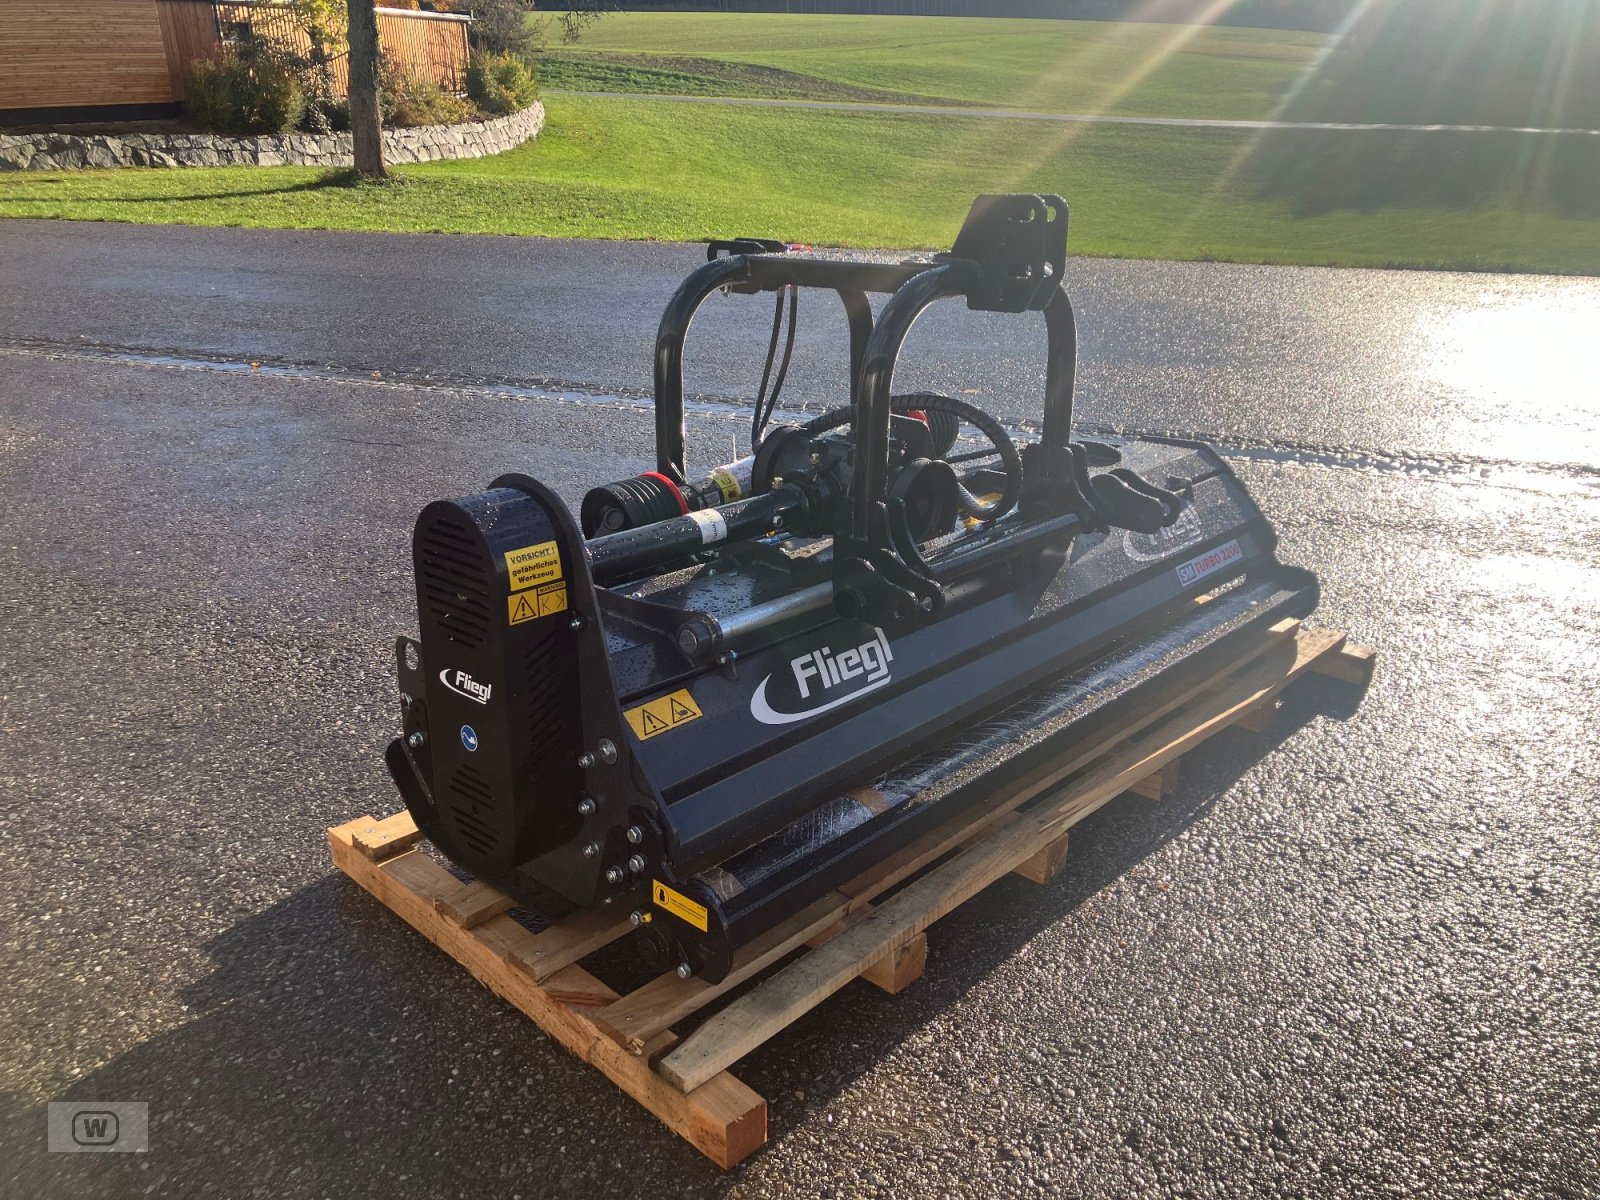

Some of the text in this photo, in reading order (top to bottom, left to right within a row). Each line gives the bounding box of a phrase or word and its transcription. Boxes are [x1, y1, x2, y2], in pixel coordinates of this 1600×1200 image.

[510, 549, 549, 564] VORSICHT
[512, 559, 558, 577] gefährliches
[1180, 565, 1195, 581] SM
[1194, 553, 1221, 574] TURBO
[518, 569, 555, 583] Werkzeug
[791, 626, 893, 699] Fliegl
[455, 670, 492, 702] Fliegl
